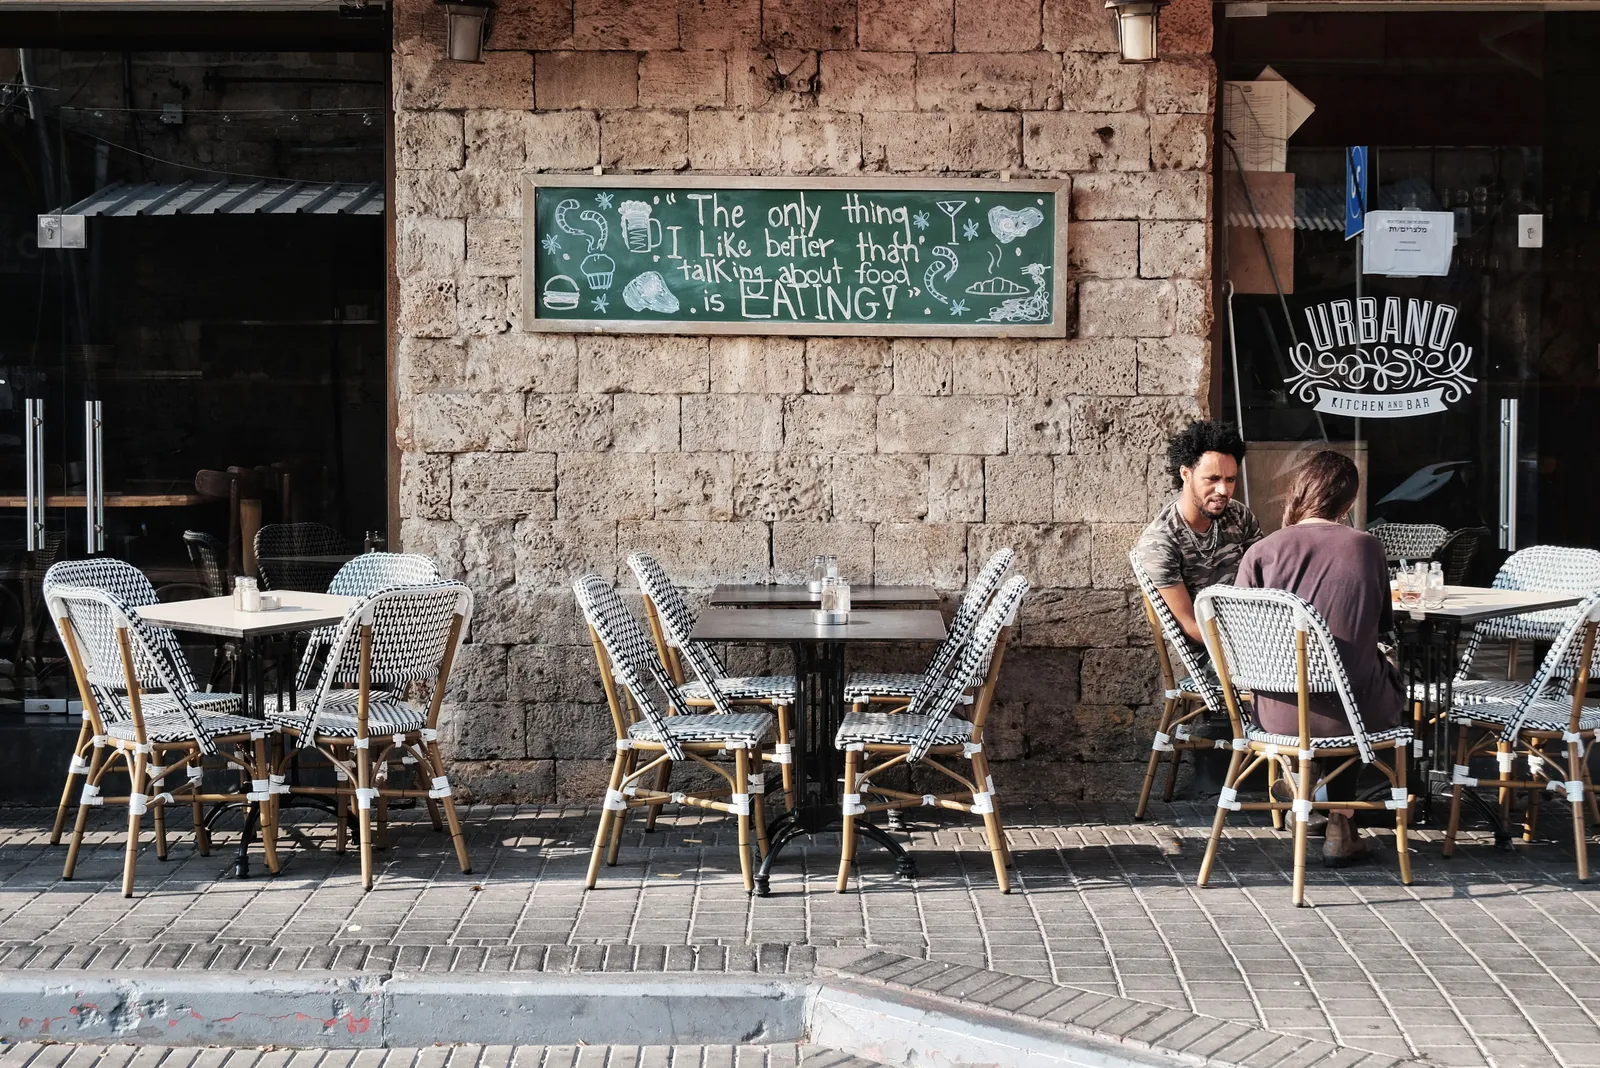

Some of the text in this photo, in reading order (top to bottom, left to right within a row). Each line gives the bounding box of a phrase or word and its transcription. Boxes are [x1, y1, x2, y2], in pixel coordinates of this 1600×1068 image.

[767, 191, 822, 237] only
[841, 193, 912, 249] thing
[666, 226, 683, 259] I
[764, 227, 835, 258] better
[856, 231, 920, 263] than
[778, 257, 844, 285] about
[854, 258, 911, 286] food
[703, 289, 725, 312] is
[1304, 296, 1458, 352] URBANO
[1331, 396, 1431, 412] KITCHEN AND BAR
